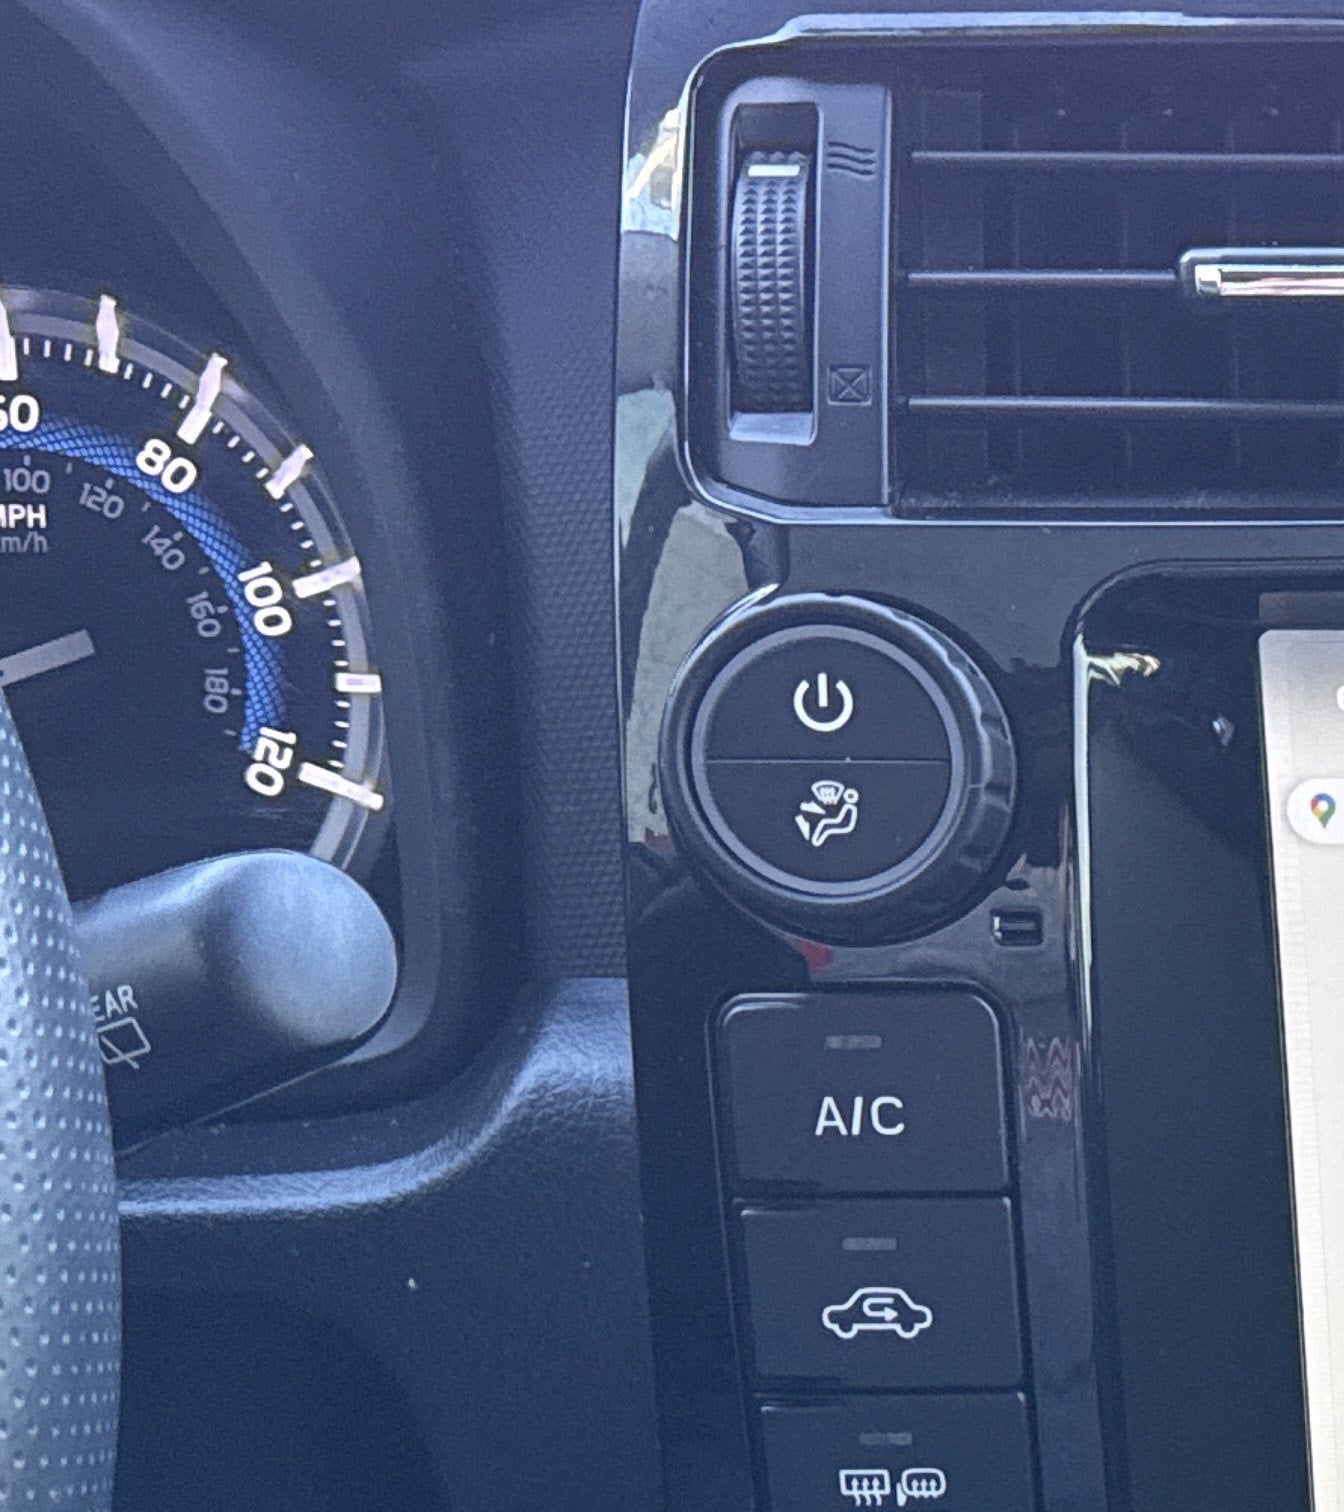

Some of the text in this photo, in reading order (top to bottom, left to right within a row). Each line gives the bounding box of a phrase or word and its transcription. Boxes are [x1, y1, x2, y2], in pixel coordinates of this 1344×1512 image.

[3, 467, 51, 494] 100
[135, 438, 197, 493] 80
[79, 482, 125, 519] 120
[0, 531, 48, 553] m/h
[141, 525, 185, 571] 140
[186, 591, 222, 638] 160
[237, 561, 292, 636] 100
[204, 667, 229, 714] 180
[245, 727, 297, 797] 120
[89, 984, 139, 1022] EAR
[815, 1096, 905, 1137] A/C
